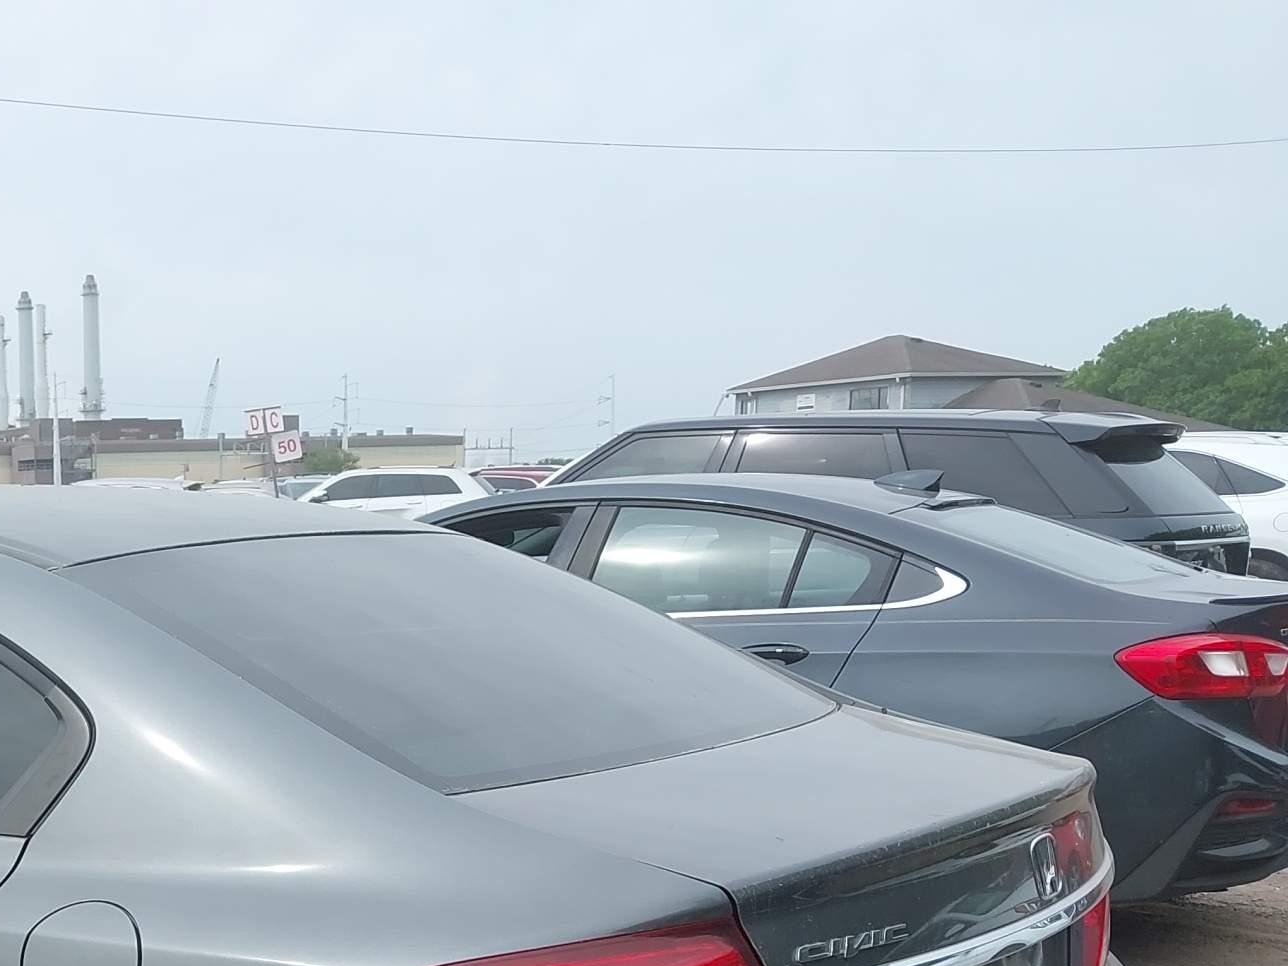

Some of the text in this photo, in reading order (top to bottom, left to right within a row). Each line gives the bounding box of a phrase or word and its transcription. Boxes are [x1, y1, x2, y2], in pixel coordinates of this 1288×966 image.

[249, 414, 259, 431] D
[270, 411, 279, 428] C
[277, 438, 297, 455] 50
[795, 922, 910, 962] CIVIC
